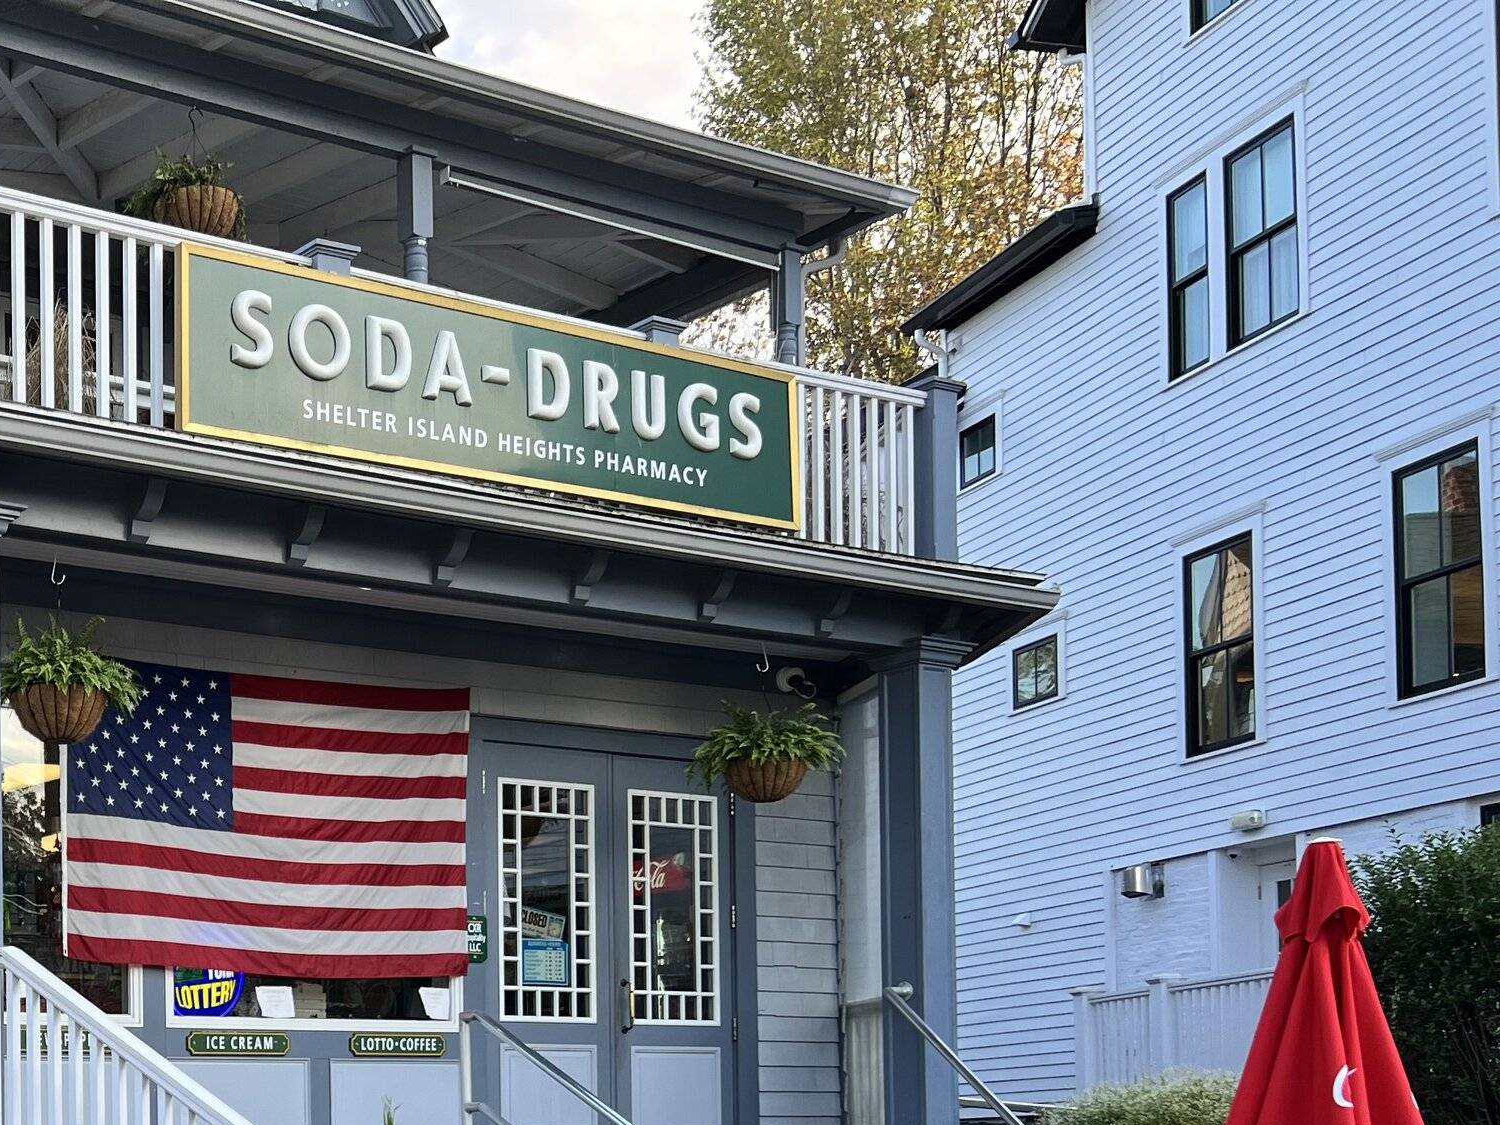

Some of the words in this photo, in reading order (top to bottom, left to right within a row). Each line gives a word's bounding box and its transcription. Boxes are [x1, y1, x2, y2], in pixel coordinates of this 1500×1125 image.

[302, 400, 397, 434] SHELTER
[408, 417, 488, 448] ISLAND
[498, 433, 586, 466] HEIGHTS
[594, 452, 708, 488] PHARMACY
[175, 979, 237, 1009] LOTTERY
[206, 1036, 225, 1050] ICE
[230, 1036, 273, 1050] CREAM
